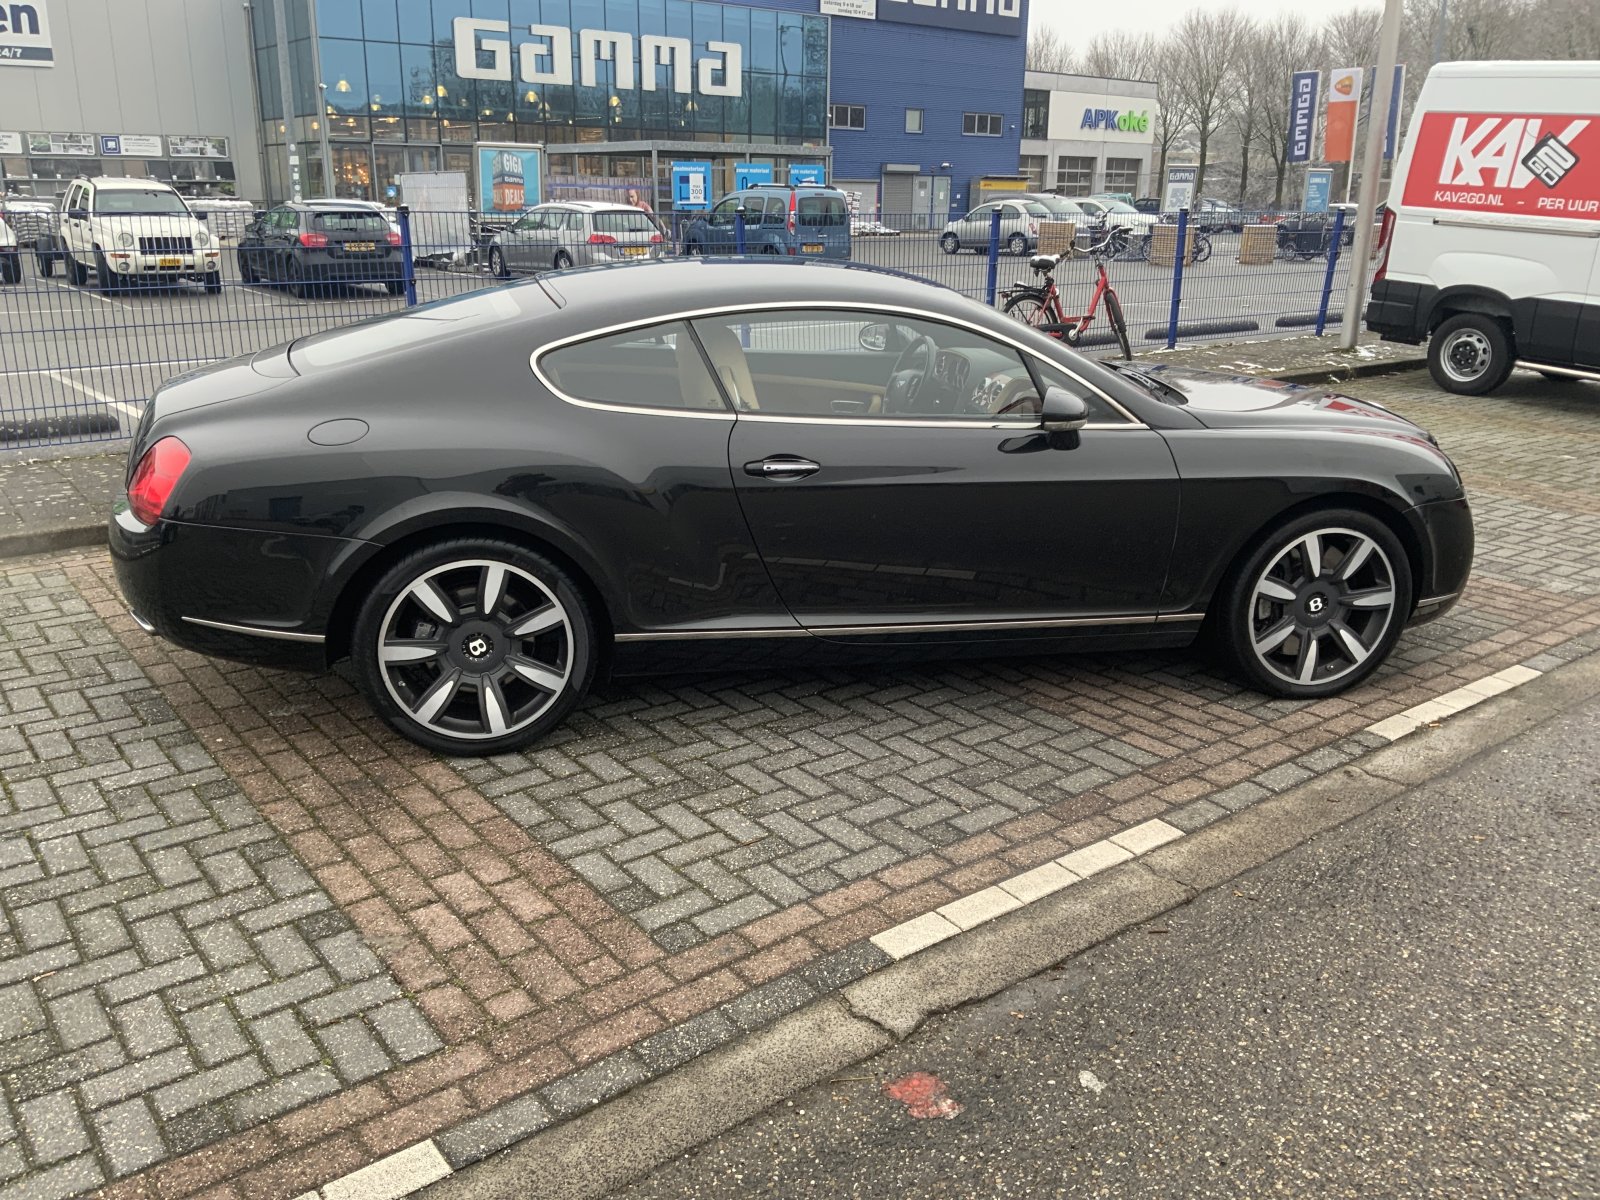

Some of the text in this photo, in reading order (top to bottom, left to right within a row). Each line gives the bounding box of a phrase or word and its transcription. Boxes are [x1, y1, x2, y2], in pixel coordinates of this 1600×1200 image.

[503, 153, 523, 175] GIGA
[505, 188, 525, 205] DEALS
[1434, 191, 1504, 206] KAV2GO.NL
[1537, 197, 1564, 210] PER
[1568, 199, 1599, 213] UUR
